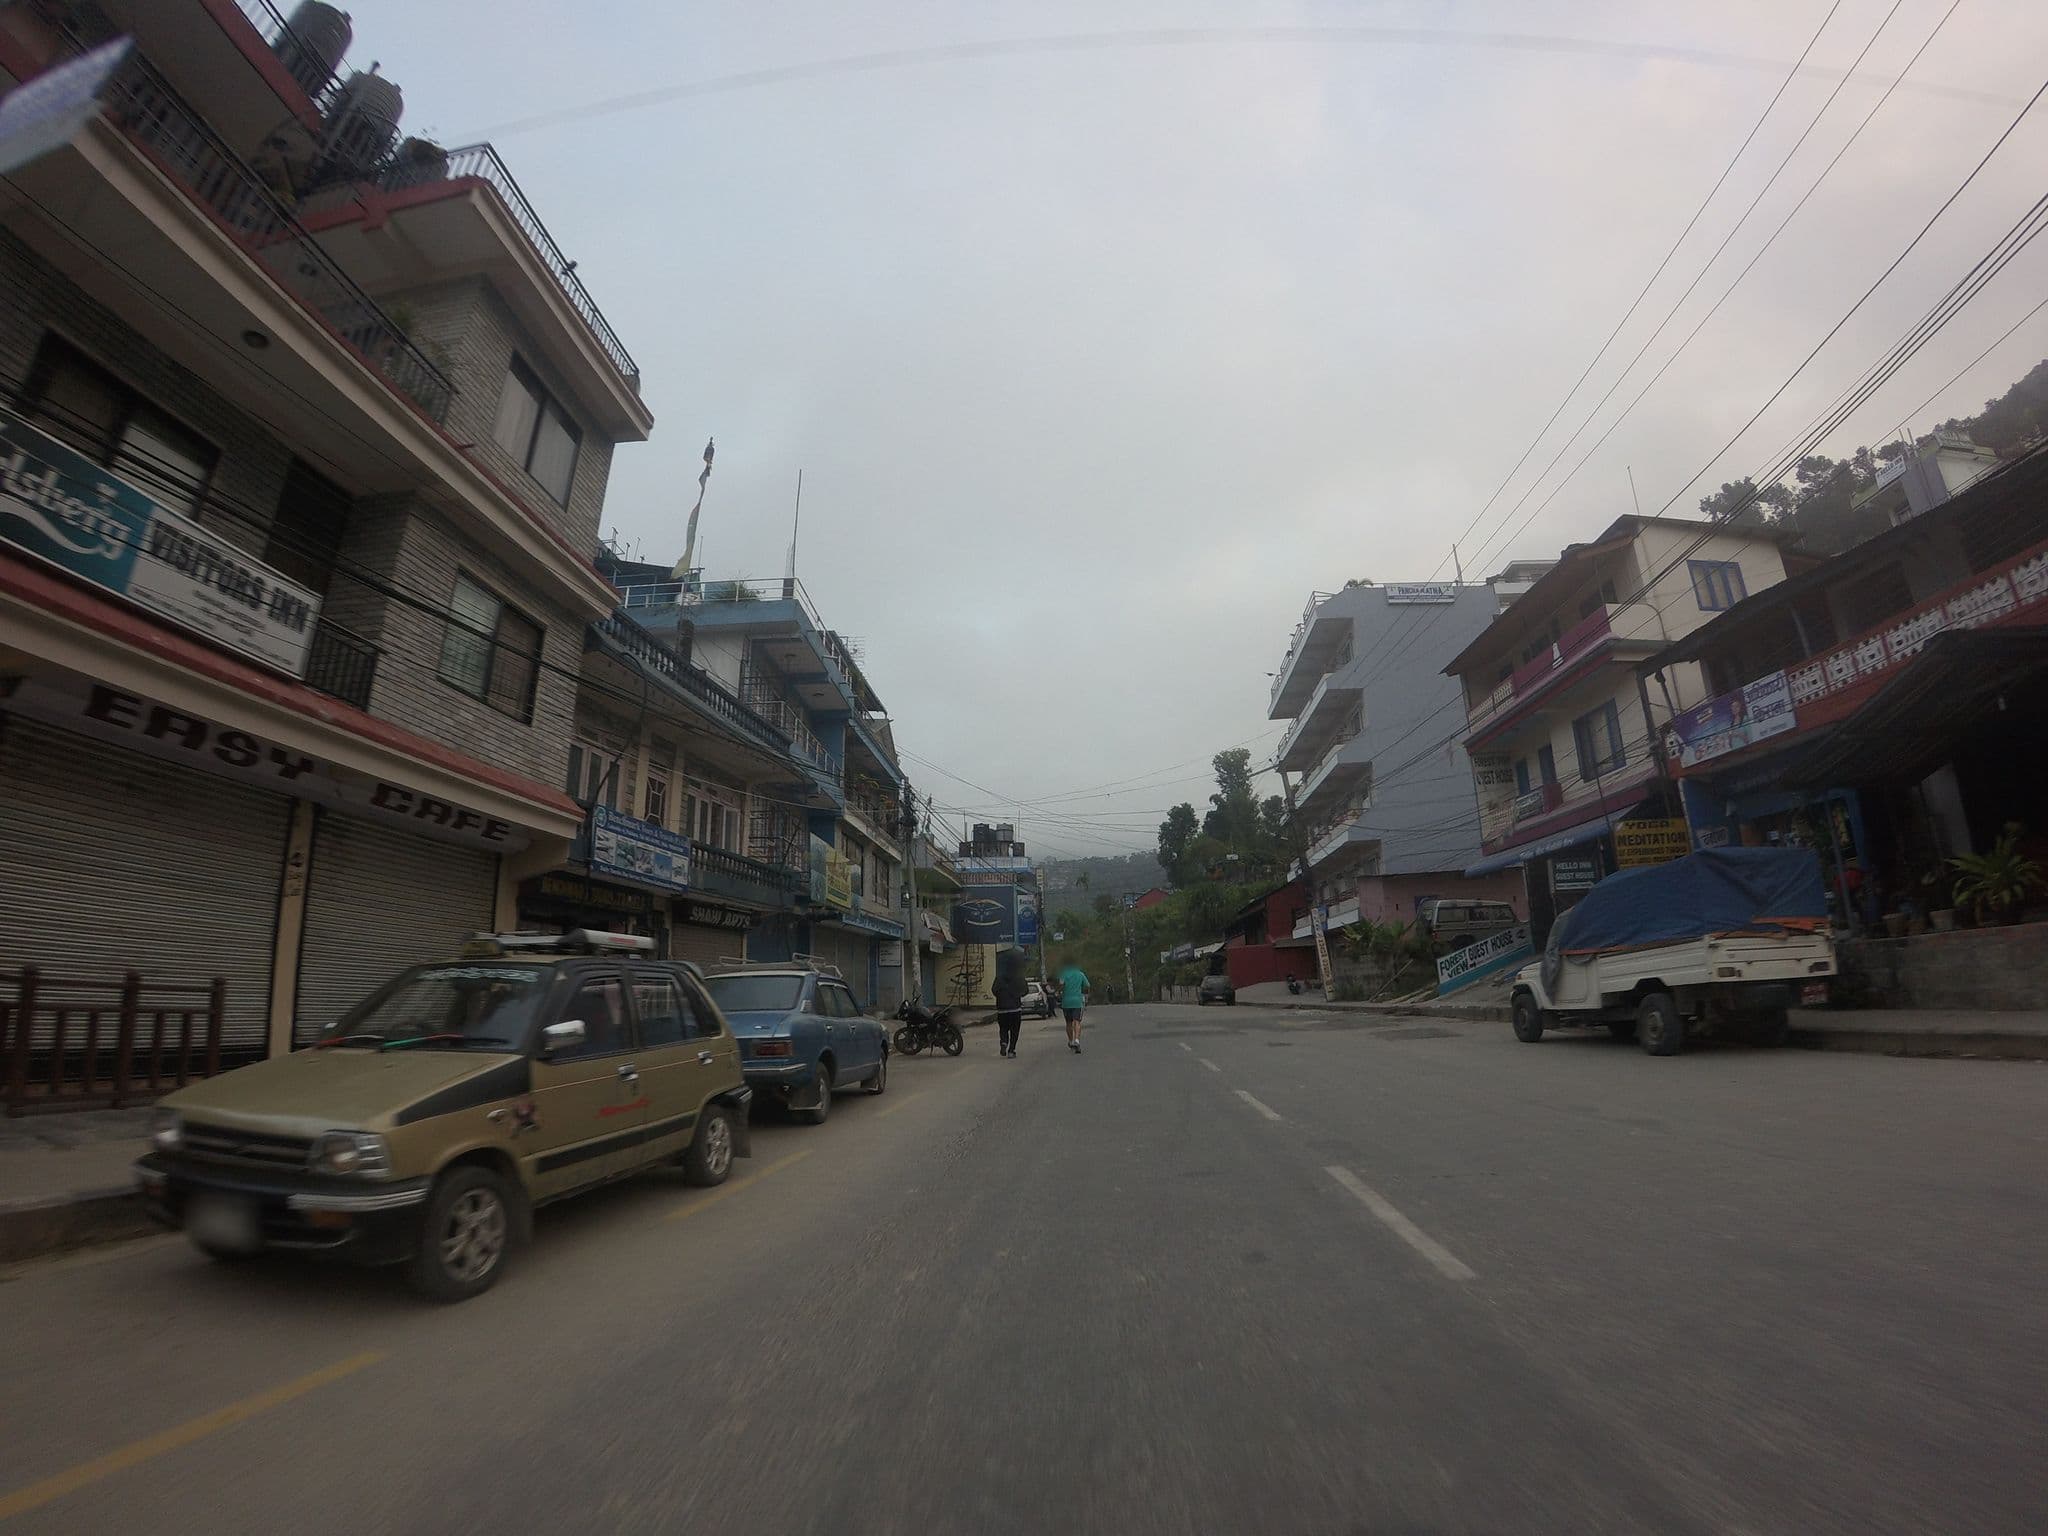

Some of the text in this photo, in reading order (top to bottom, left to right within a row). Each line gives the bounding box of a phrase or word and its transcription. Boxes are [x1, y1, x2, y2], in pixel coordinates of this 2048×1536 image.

[0, 447, 134, 560] lsberg
[151, 519, 264, 610] VISITORS
[267, 587, 311, 634] INN
[82, 684, 512, 842] EASY CAFE
[1625, 821, 1669, 830] YOGA
[1617, 832, 1686, 847] MEDITATION
[1555, 862, 1577, 870] HELLO
[1555, 871, 1597, 880] GUEST HOUSE
[722, 911, 751, 928] ARTS
[1439, 949, 1467, 976] FOREST
[1468, 940, 1489, 961] GUEST
[1490, 930, 1514, 952] HOUSE
[1447, 960, 1468, 978] VIEW
